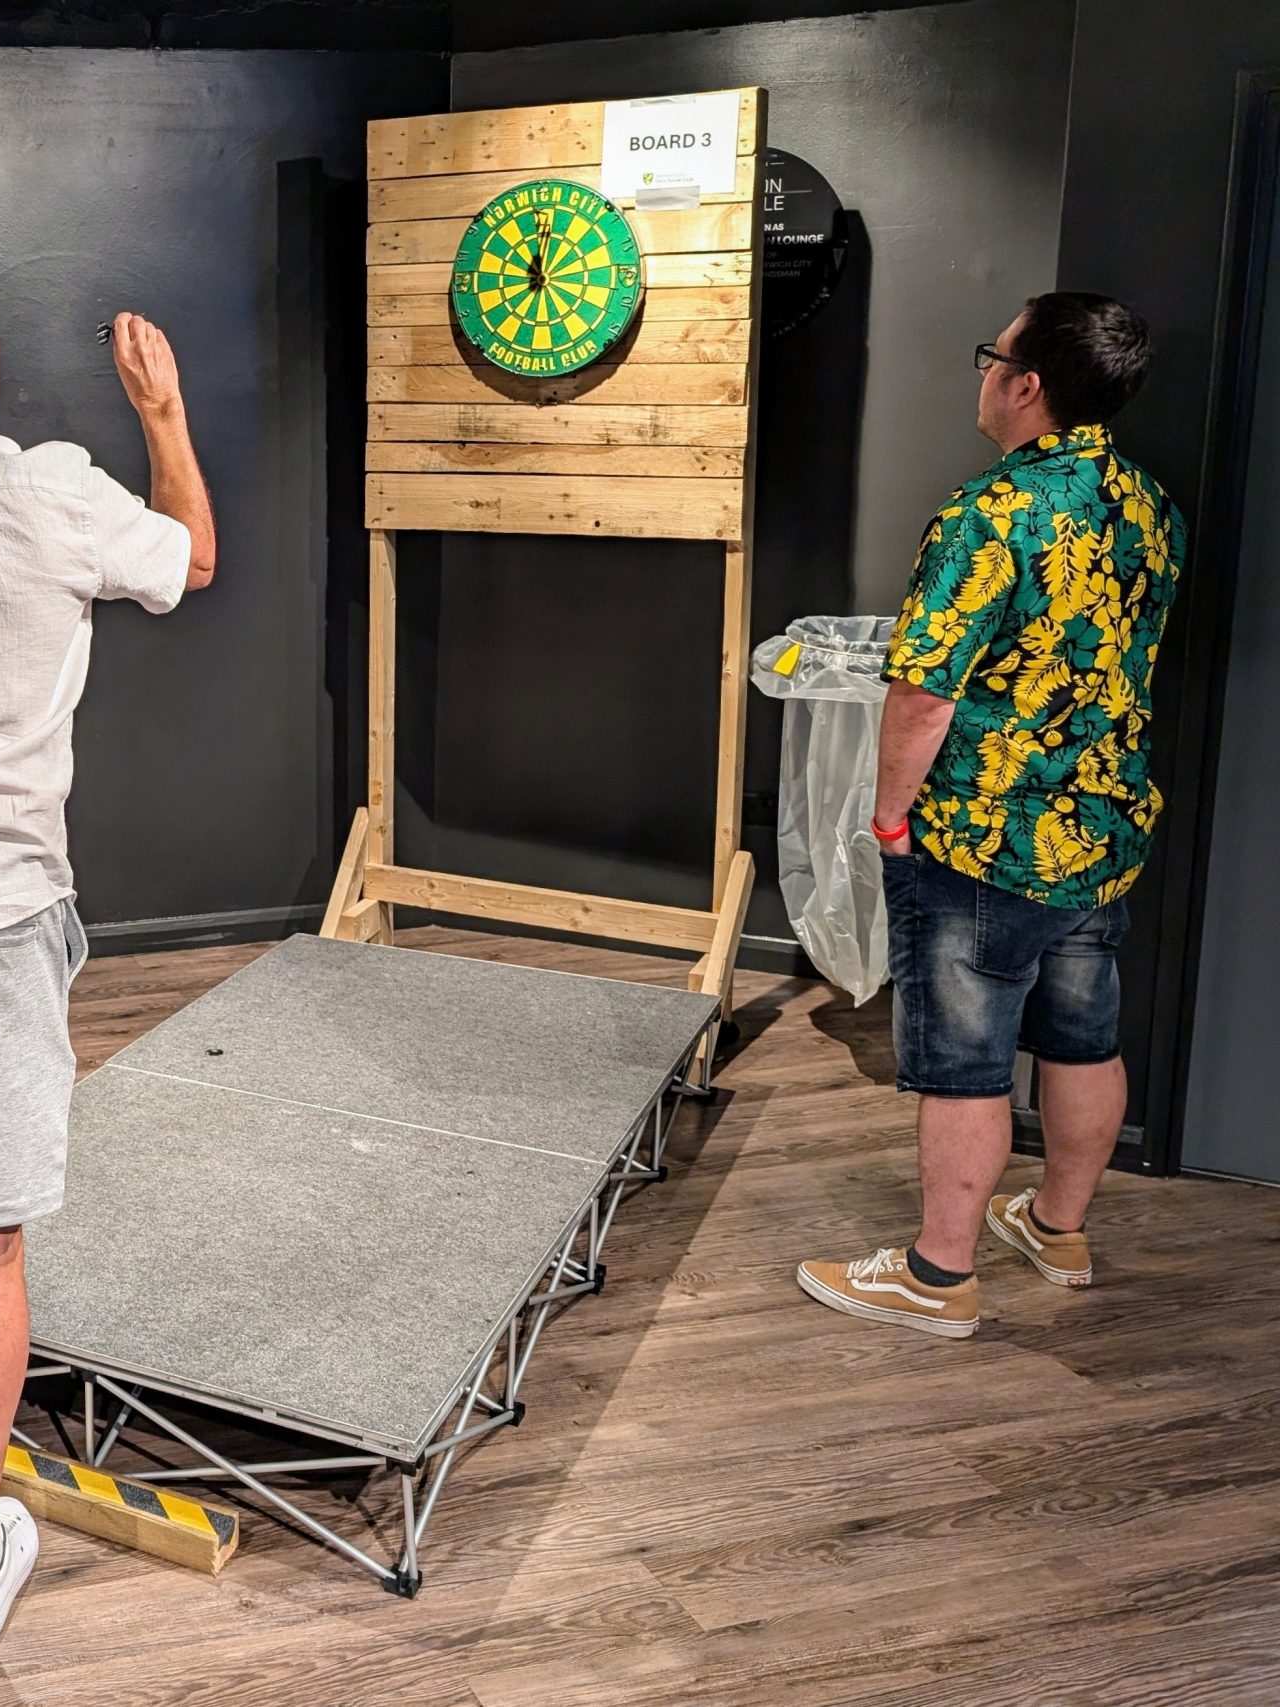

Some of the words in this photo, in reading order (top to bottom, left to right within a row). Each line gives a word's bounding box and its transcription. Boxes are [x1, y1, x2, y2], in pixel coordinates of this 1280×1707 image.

[629, 133, 696, 151] BOARD
[701, 132, 712, 147] 3
[483, 186, 562, 228] NORWICH
[568, 190, 609, 220] CITY
[772, 222, 785, 231] AS
[776, 233, 825, 246] LOUNGE
[487, 341, 557, 371] FOOTBALL
[560, 340, 598, 368] CLUB
